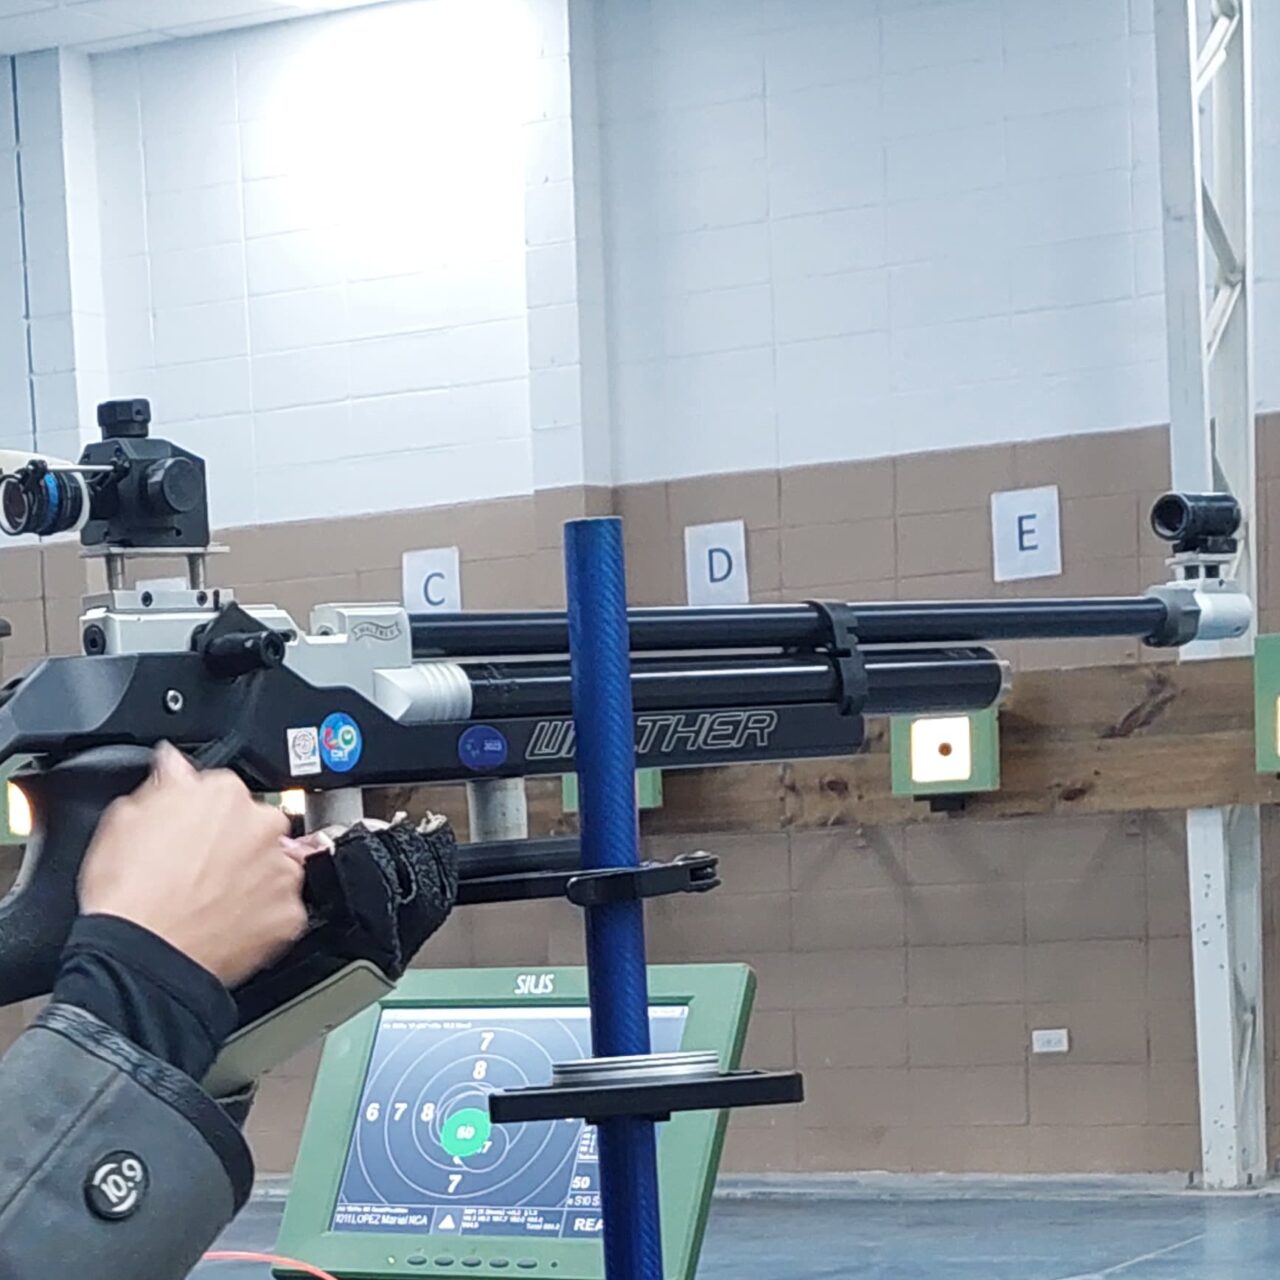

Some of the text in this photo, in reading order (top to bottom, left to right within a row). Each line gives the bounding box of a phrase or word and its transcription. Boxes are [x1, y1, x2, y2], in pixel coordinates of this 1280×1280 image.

[1018, 513, 1039, 551] E
[708, 547, 733, 583] D
[423, 572, 446, 607] C
[524, 710, 778, 760] WTHER
[514, 973, 555, 994] SIUS
[480, 1031, 495, 1051] 7
[472, 1060, 487, 1080] 8
[365, 1102, 435, 1122] 6 7 8
[447, 1174, 462, 1194] 7
[571, 1176, 591, 1190] 50
